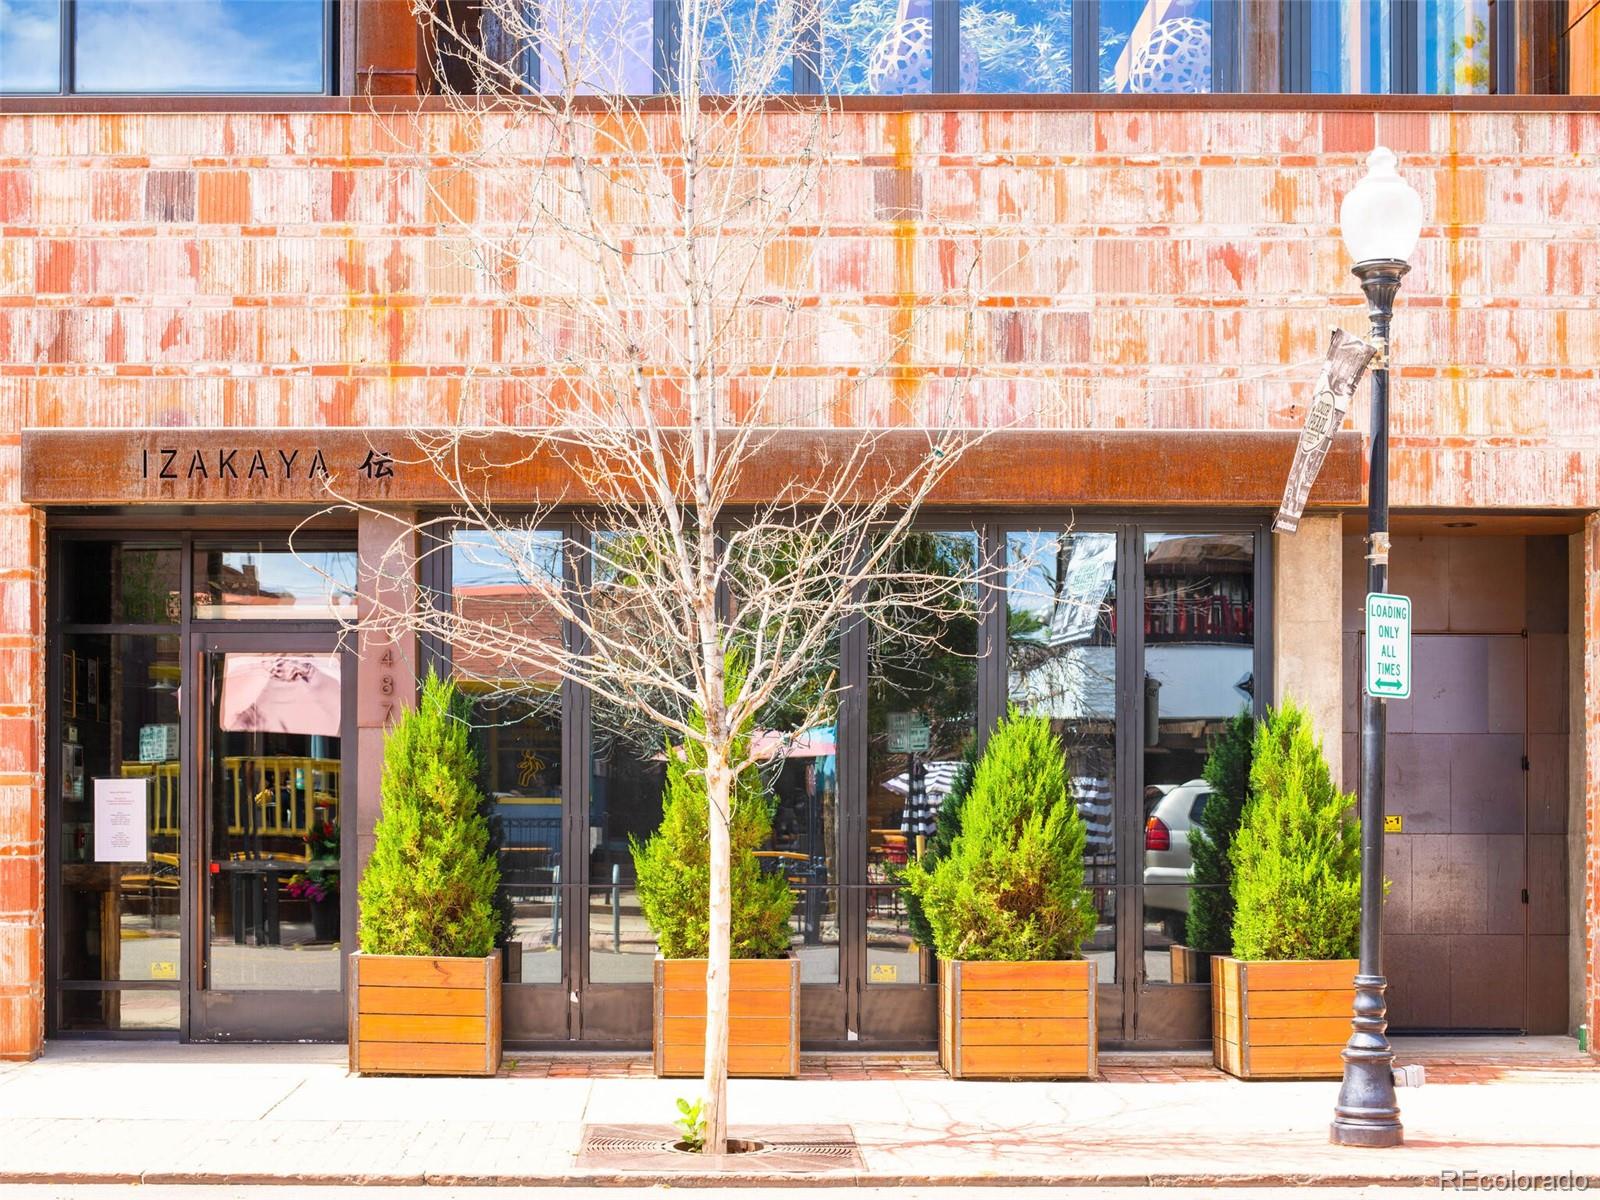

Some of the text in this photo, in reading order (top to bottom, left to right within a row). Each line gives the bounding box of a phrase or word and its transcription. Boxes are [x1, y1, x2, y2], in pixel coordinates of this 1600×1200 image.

[143, 449, 394, 479] IZAKAYA 伝
[1371, 604, 1407, 620] LOADING
[1378, 625, 1400, 639] ONLY
[1381, 644, 1397, 658] ALL
[1377, 662, 1401, 677] TIMES
